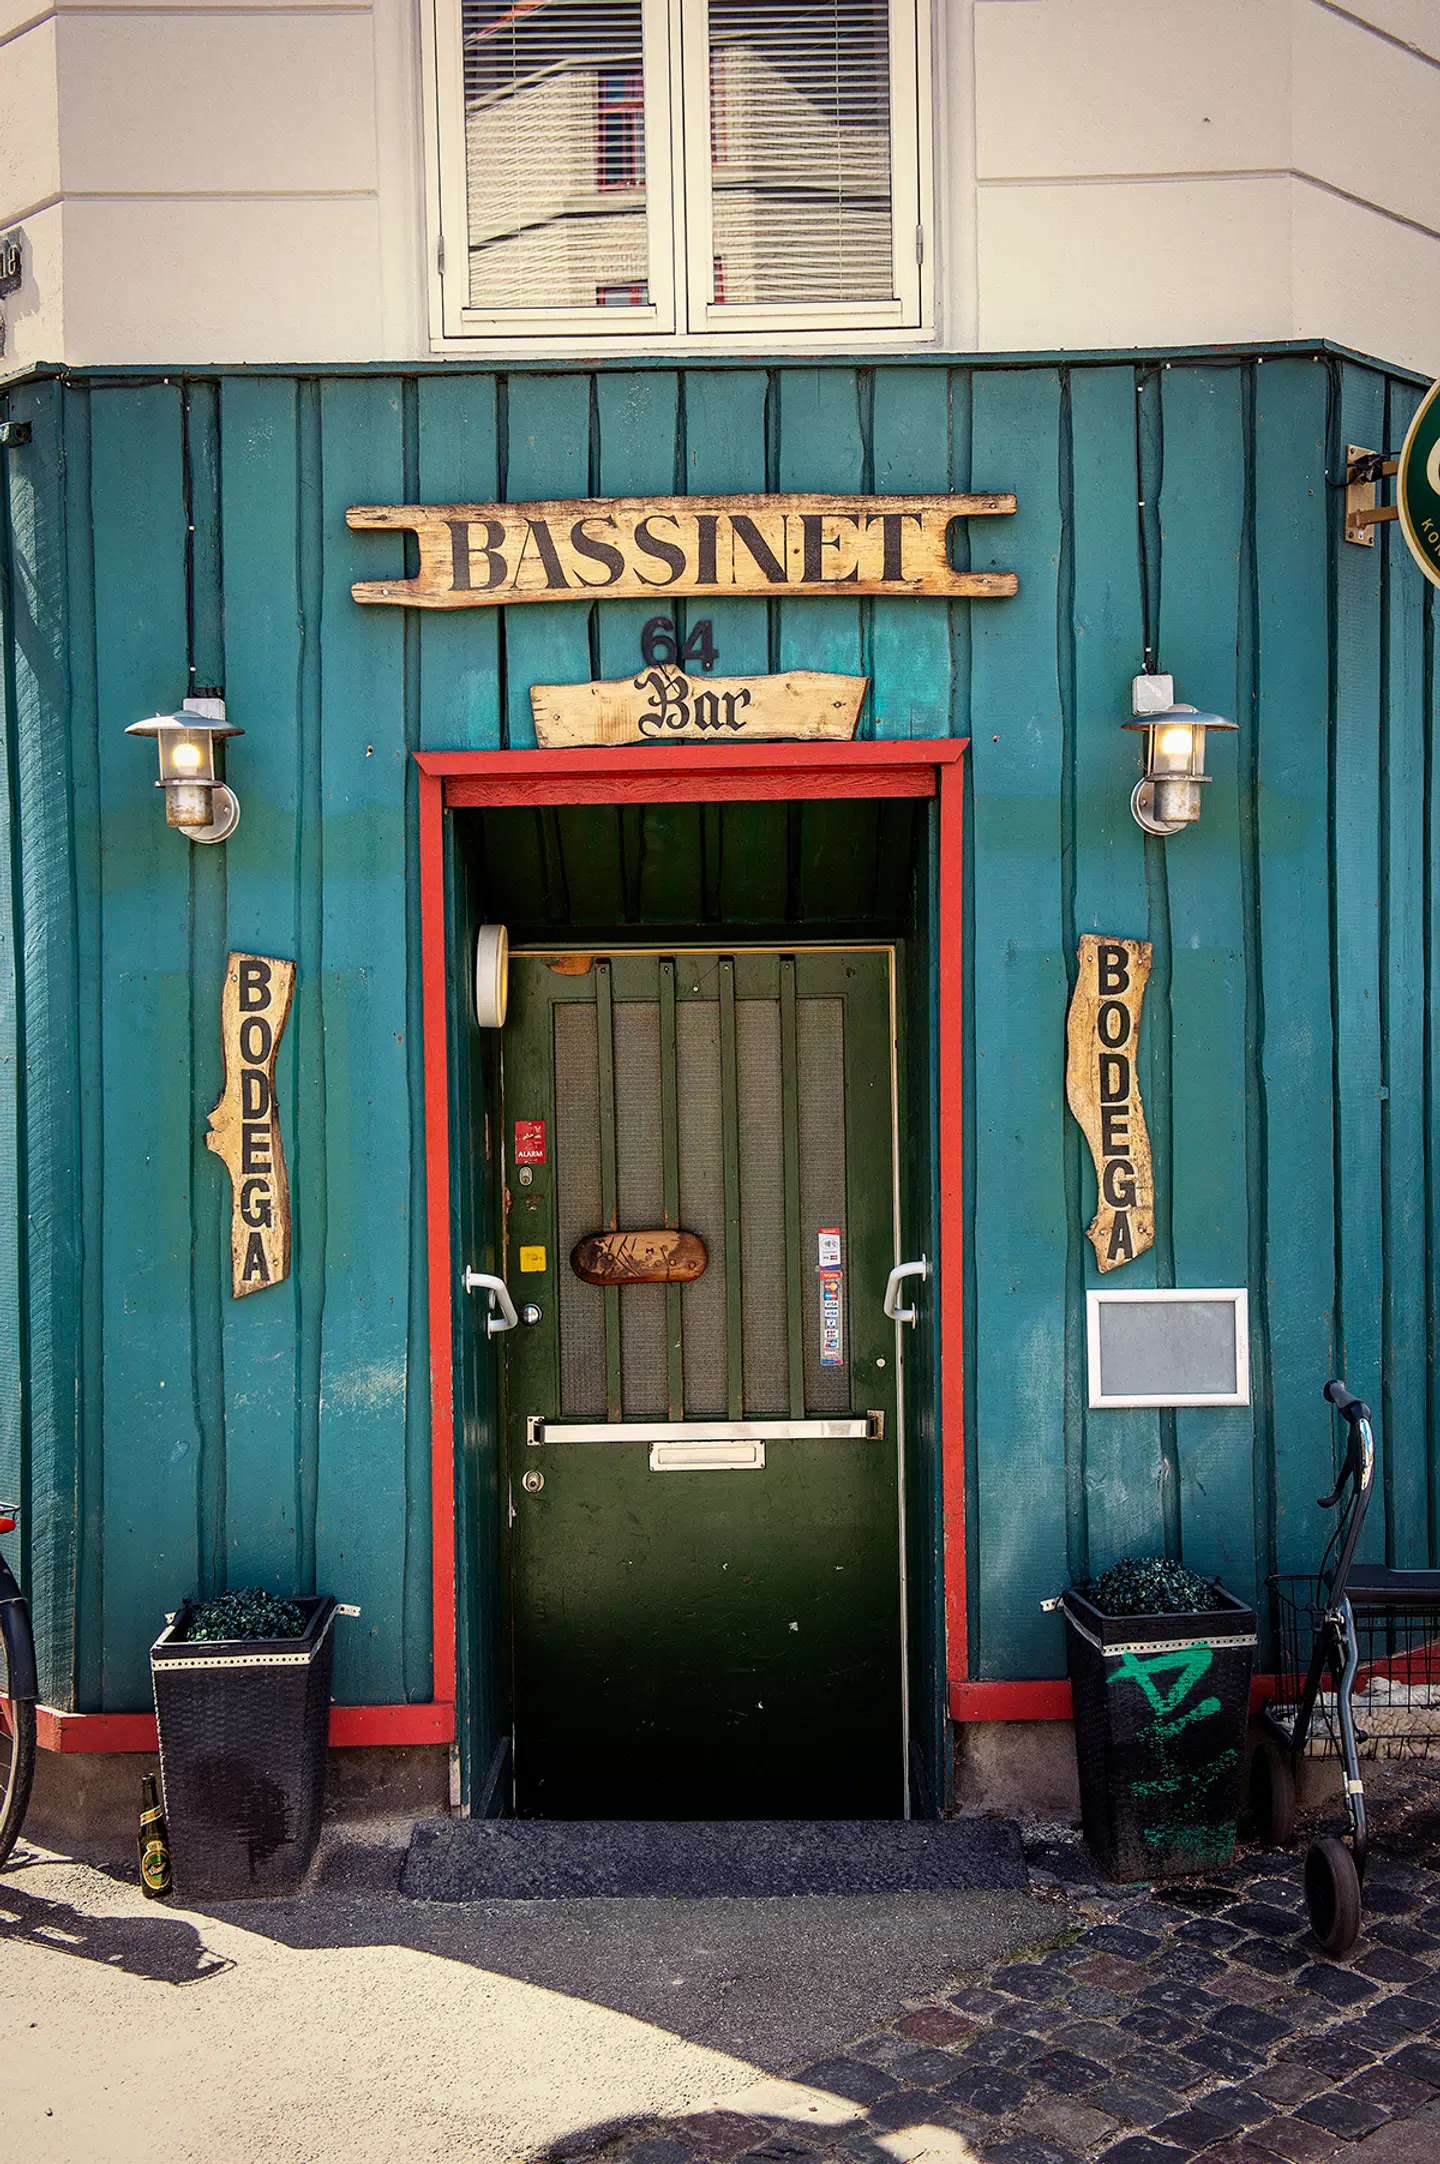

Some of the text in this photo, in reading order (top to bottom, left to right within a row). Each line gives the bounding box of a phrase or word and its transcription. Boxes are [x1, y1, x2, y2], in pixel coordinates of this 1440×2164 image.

[444, 513, 922, 592] BASSINET
[641, 616, 719, 671] 64
[634, 671, 751, 737] Bar
[238, 959, 273, 1282] BODEGA
[1097, 945, 1137, 1261] BODEGA
[518, 1150, 543, 1158] ALARM
